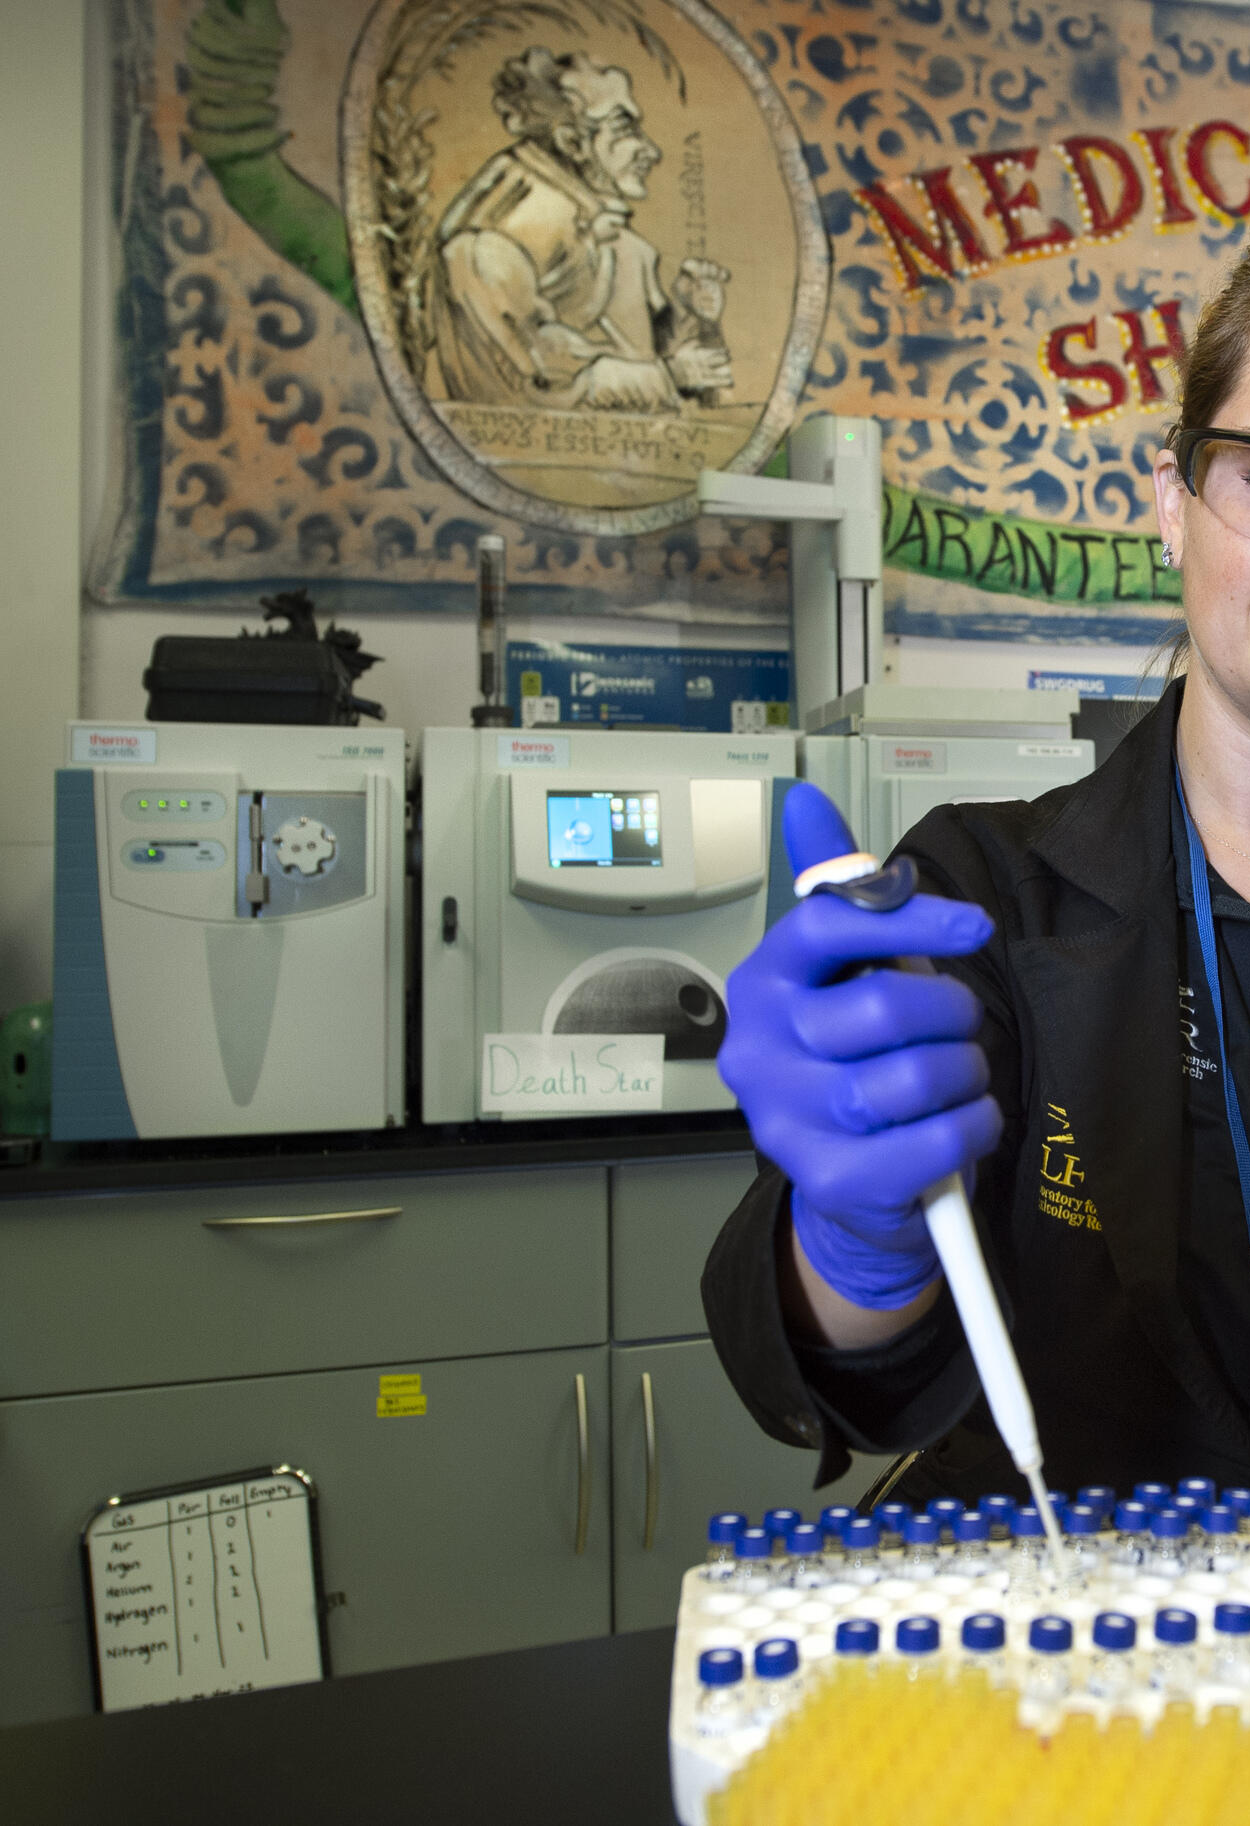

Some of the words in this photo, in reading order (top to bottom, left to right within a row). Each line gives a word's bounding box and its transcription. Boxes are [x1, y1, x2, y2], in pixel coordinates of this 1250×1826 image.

[89, 733, 139, 747] thermo
[511, 741, 554, 752] thermo
[894, 747, 933, 759] thermo
[488, 1043, 587, 1097] Death
[596, 1042, 656, 1094] Star
[111, 1513, 136, 1529] Gas
[249, 1482, 292, 1501] Empty
[110, 1540, 133, 1553] Air
[105, 1582, 154, 1599] Helium
[105, 1640, 169, 1666] Nitrogen
